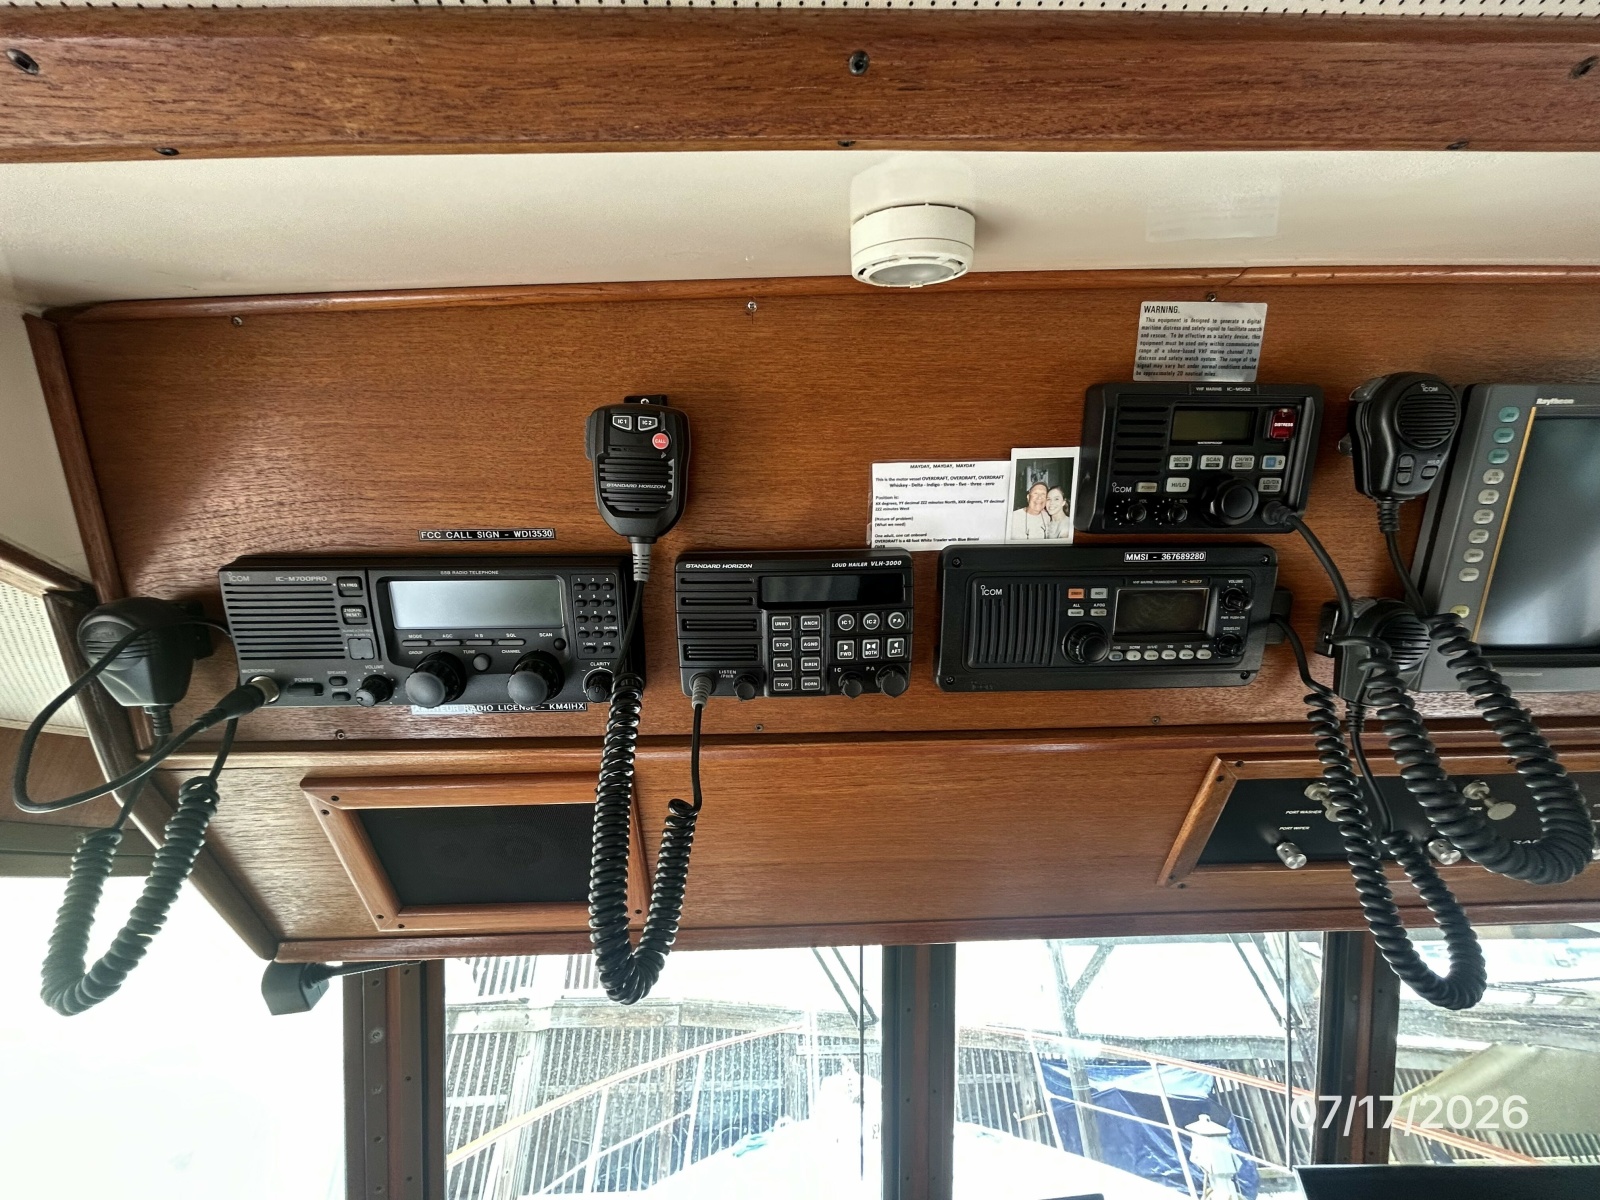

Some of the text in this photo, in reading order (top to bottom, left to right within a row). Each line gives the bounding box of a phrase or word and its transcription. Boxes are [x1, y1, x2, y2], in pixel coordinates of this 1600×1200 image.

[1143, 305, 1180, 314] WARNING.
[1536, 397, 1574, 406] Raytheon
[420, 530, 442, 539] FCC
[446, 530, 472, 539] CALL
[477, 530, 500, 538] SIGN
[513, 530, 553, 538] WDI3530
